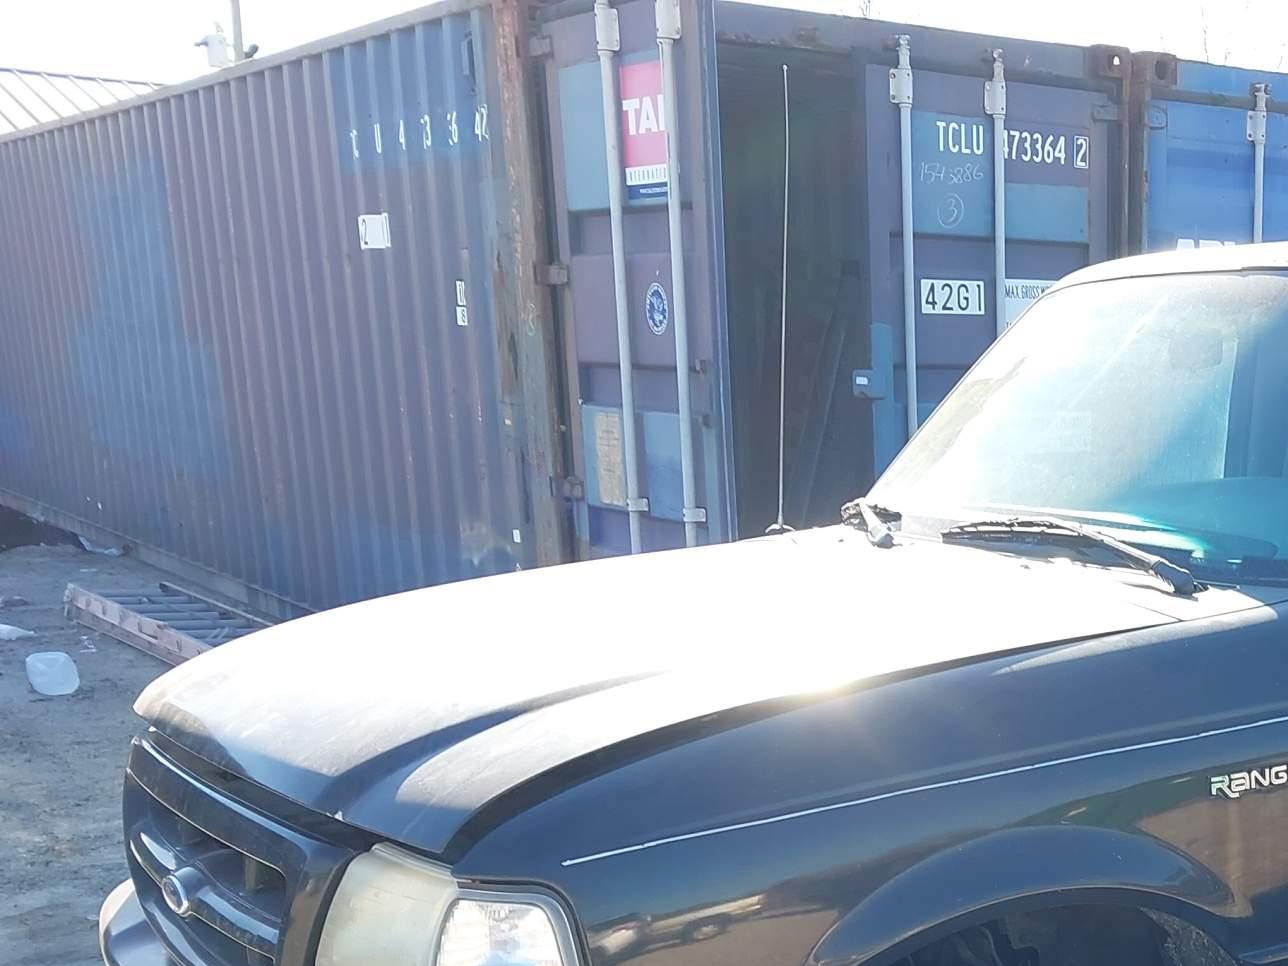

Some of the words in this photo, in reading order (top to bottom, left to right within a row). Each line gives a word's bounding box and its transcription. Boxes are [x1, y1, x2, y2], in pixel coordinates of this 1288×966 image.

[936, 121, 984, 155] TCLU
[1075, 138, 1088, 167] 2
[925, 282, 982, 312] 42G1
